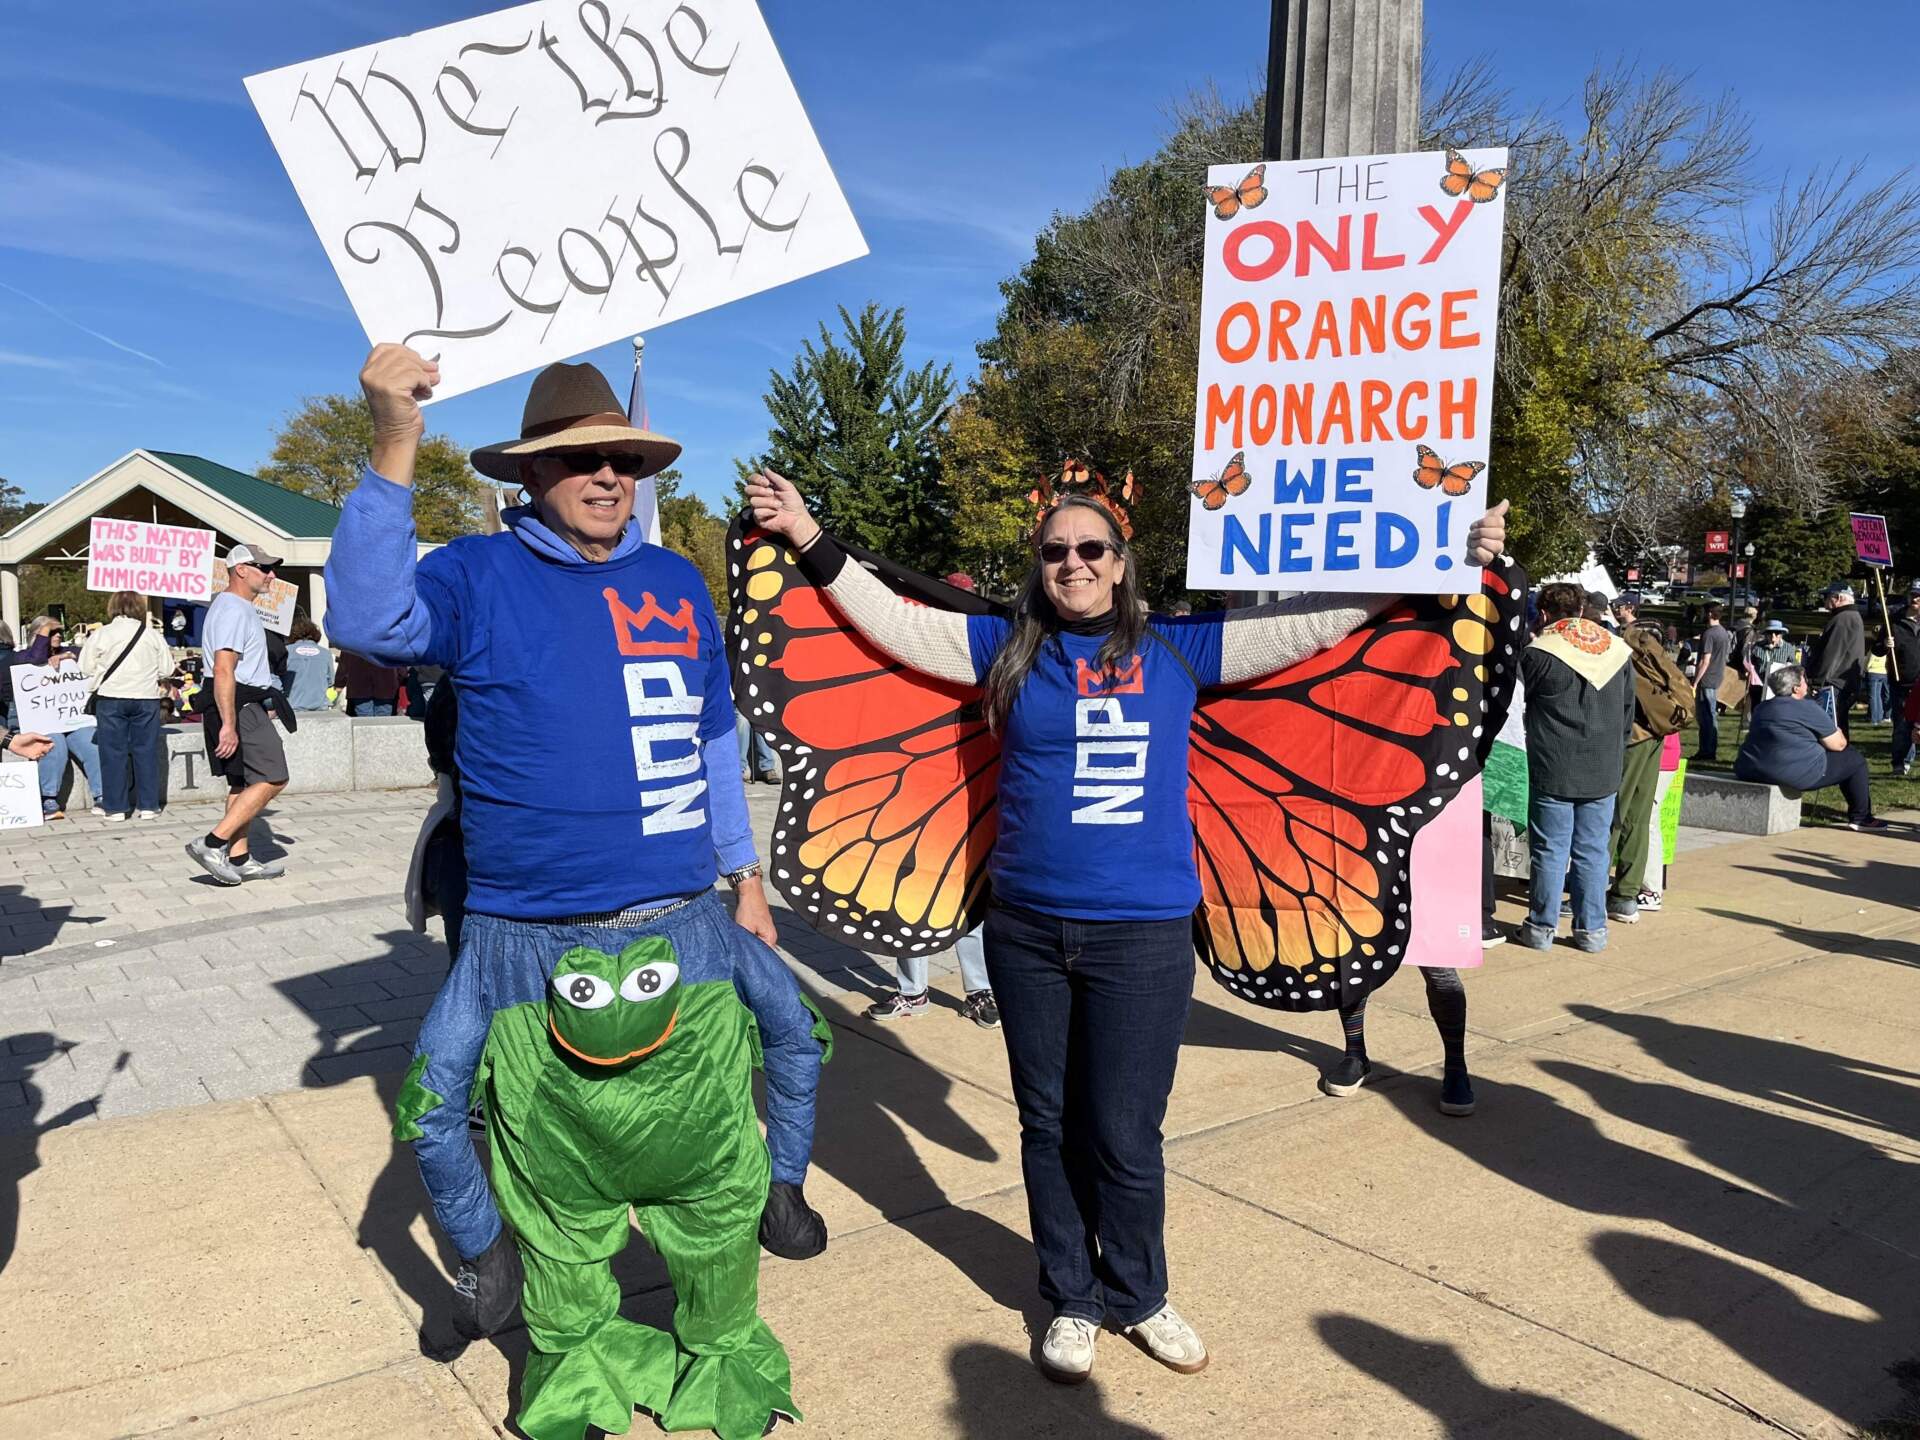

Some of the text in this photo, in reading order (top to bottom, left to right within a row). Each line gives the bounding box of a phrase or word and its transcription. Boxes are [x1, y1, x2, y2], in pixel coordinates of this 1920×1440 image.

[290, 0, 740, 194] We the
[1298, 161, 1389, 205] THE
[344, 126, 811, 346] People
[1222, 199, 1475, 282] ONLY
[1215, 288, 1481, 364] ORANGE
[1204, 377, 1478, 451] MONARCH
[1273, 456, 1375, 505] WE
[92, 543, 203, 568] WAS BUILT BY
[93, 521, 211, 551] THIS NATION
[1219, 502, 1454, 576] NEED!
[1709, 542, 1725, 550] WPI
[1864, 543, 1881, 554] NOW
[93, 566, 207, 595] IMMIGRANTS
[31, 689, 85, 710] SHOW
